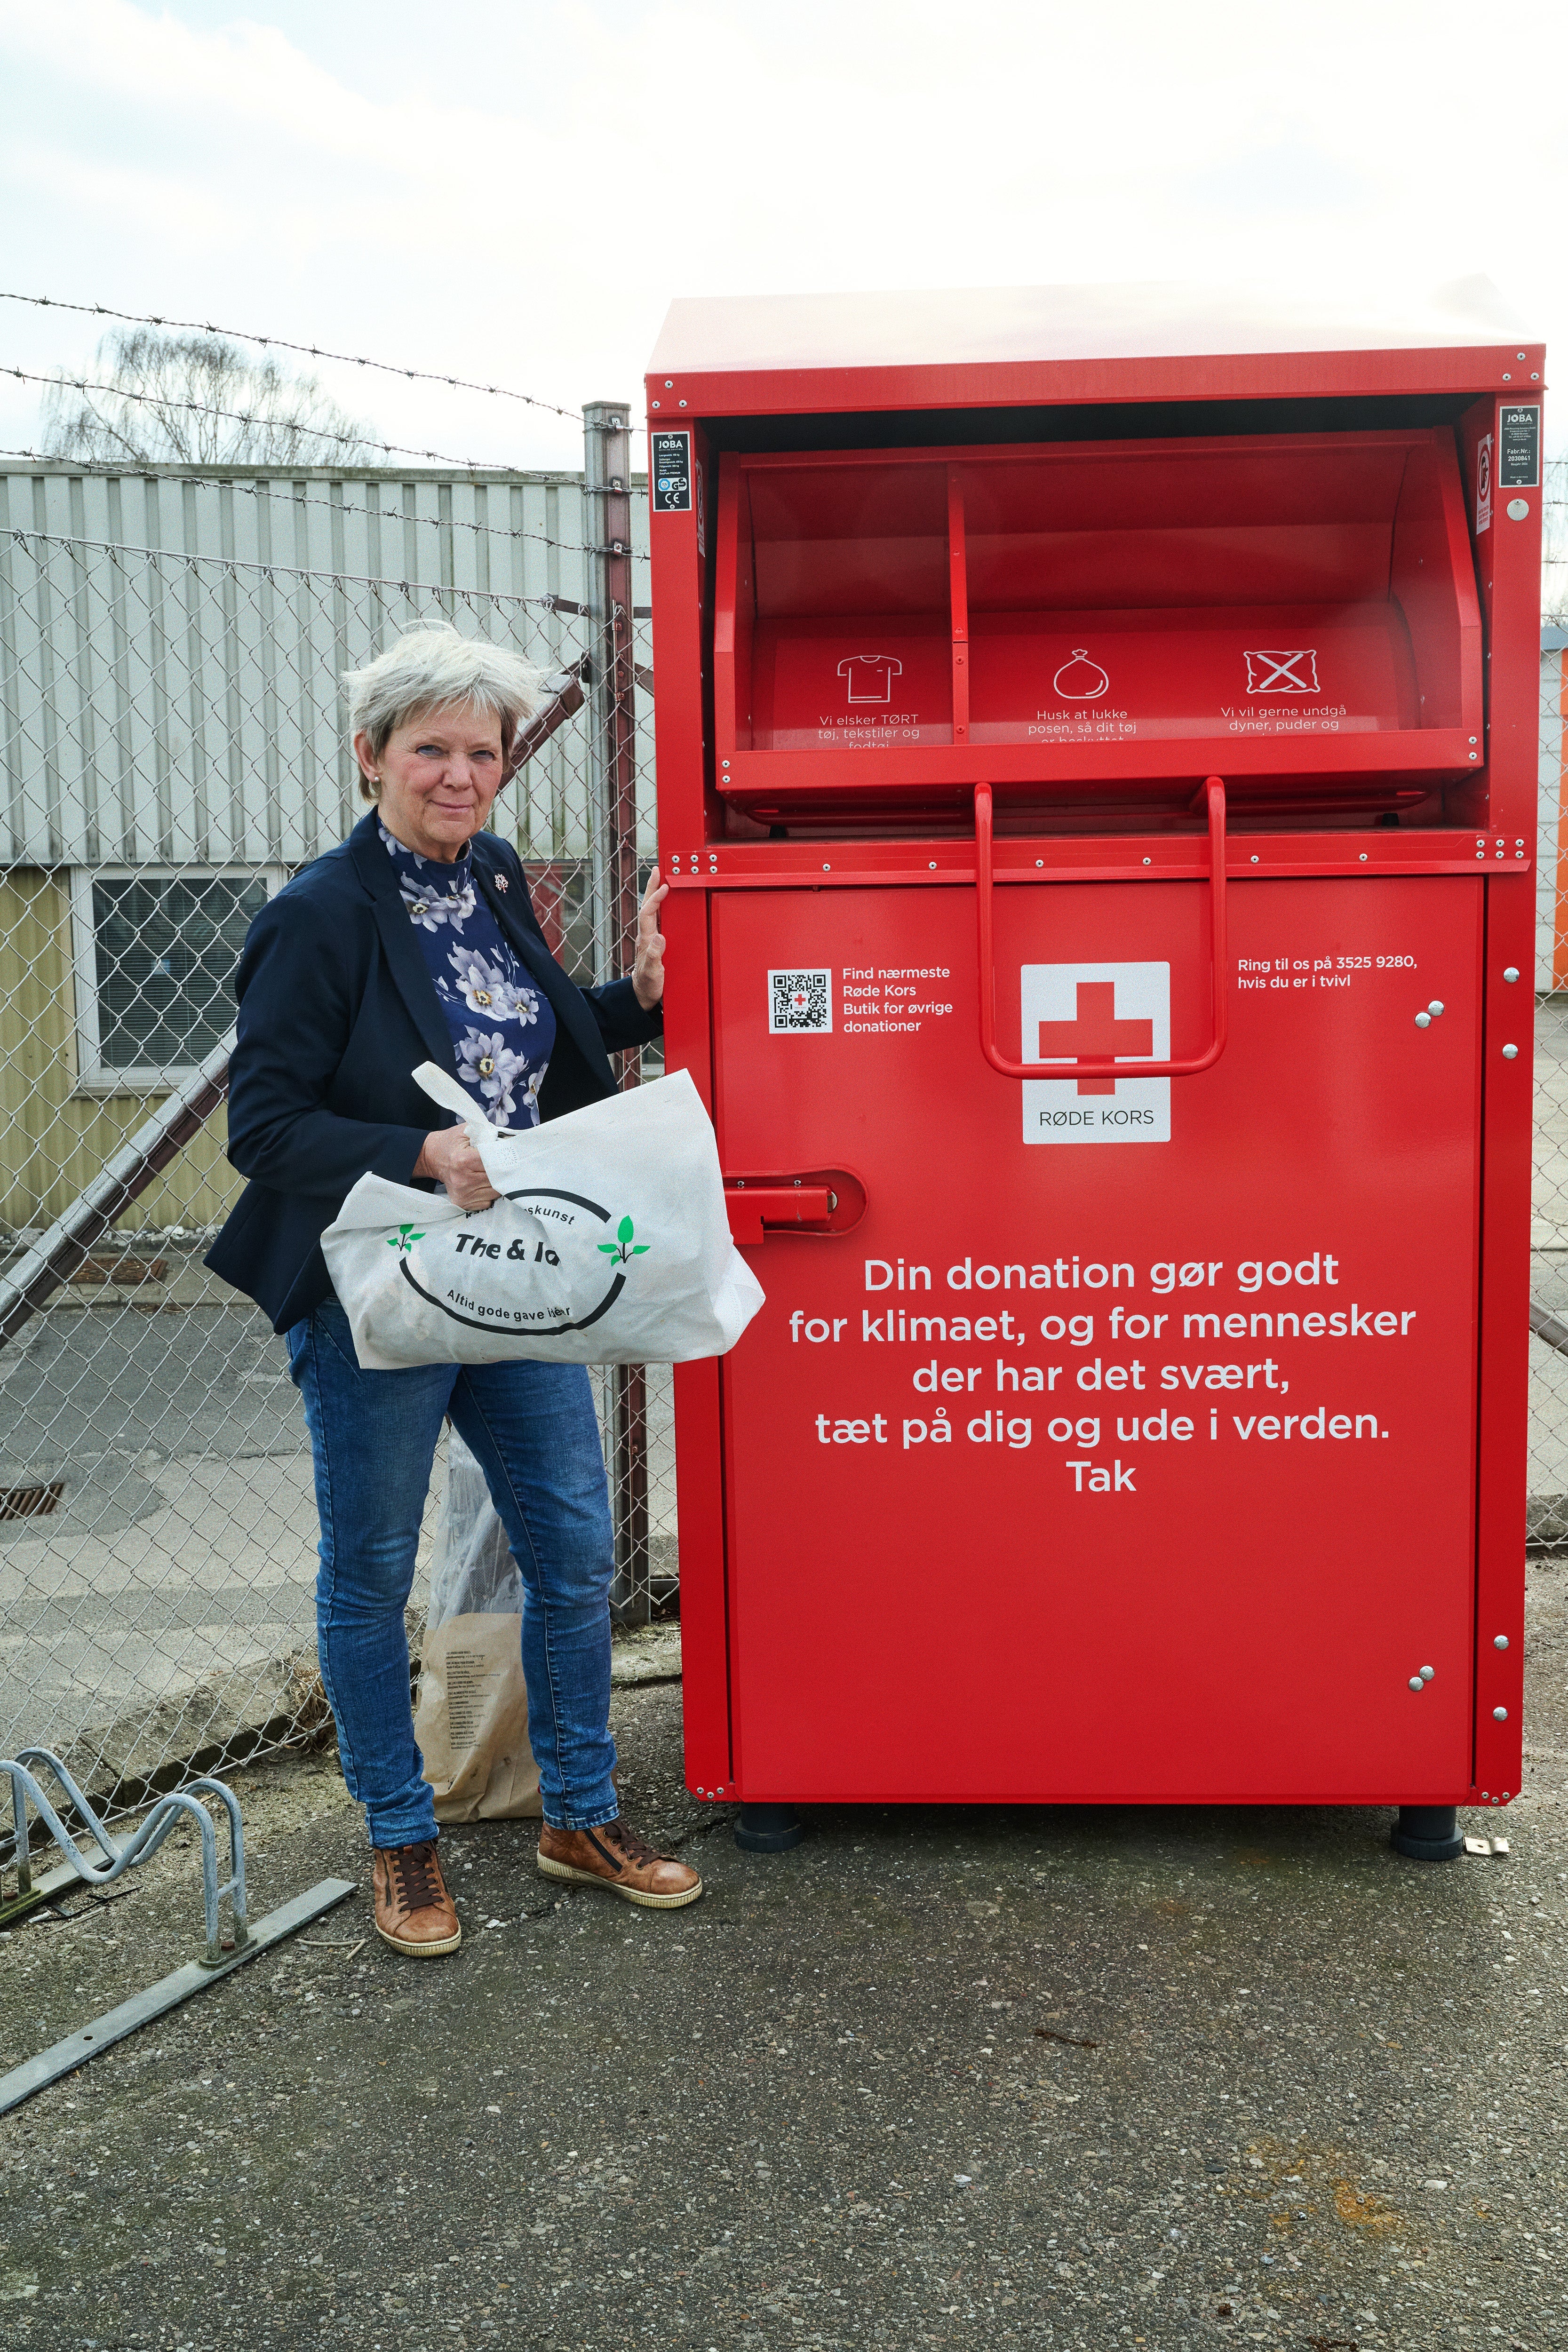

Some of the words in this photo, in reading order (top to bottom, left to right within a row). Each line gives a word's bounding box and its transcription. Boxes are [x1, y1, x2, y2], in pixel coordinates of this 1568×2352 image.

[1507, 414, 1532, 422] JOBA
[659, 440, 683, 449] JOBA
[672, 478, 686, 490] GS
[665, 493, 679, 504] CE
[1037, 710, 1070, 720] Husk
[1075, 710, 1088, 720] at
[1092, 709, 1127, 719] lukke
[1221, 707, 1234, 717] Vi
[1239, 707, 1254, 717] vil
[1259, 707, 1298, 718] gerne
[1303, 705, 1346, 717] undgå
[820, 716, 832, 725] Vi
[837, 716, 876, 725] elsker
[882, 715, 918, 724] TØRT
[1229, 720, 1271, 732] dyner,
[1276, 720, 1316, 731] puder
[1321, 720, 1339, 731] og
[819, 729, 839, 740] tøj,
[844, 728, 898, 738] tekstiler
[903, 728, 920, 739] og
[1028, 724, 1073, 735] posen,
[1078, 722, 1091, 732] så
[1097, 723, 1114, 732] dit
[1119, 722, 1136, 734] tøj
[1238, 959, 1271, 973] Ring
[1275, 958, 1288, 970] til
[1293, 960, 1310, 970] os
[1314, 955, 1332, 972] på
[1336, 956, 1371, 969] 3525
[1376, 955, 1417, 969] 9280,
[843, 967, 874, 979] Find
[878, 967, 950, 979] nærmeste
[1238, 976, 1266, 989] hvis
[1270, 976, 1289, 988] du
[1293, 978, 1308, 988] er
[1312, 975, 1315, 987] i
[1320, 974, 1350, 987] tvivl
[843, 985, 880, 997] Røde
[884, 985, 916, 996] Kors
[844, 1002, 880, 1015] Butik
[883, 1002, 904, 1014] for
[907, 1001, 953, 1016] øvrige
[844, 1020, 922, 1033] donationer
[1040, 1111, 1094, 1126] RØDE
[1102, 1110, 1154, 1125] KORS
[524, 1205, 575, 1225] skunst
[455, 1233, 501, 1259] The
[507, 1239, 525, 1260] &
[865, 1258, 931, 1291] Din
[947, 1255, 1134, 1290] donation
[1150, 1262, 1223, 1294] gør
[1237, 1252, 1339, 1293] godt
[447, 1290, 474, 1311] Altid
[478, 1306, 510, 1318] gode
[514, 1311, 544, 1322] gave
[789, 1310, 848, 1343] for
[862, 1309, 1025, 1346] klimaet,
[1041, 1315, 1093, 1346] og
[1109, 1306, 1169, 1339] for
[1184, 1303, 1416, 1338] mennesker
[913, 1359, 982, 1392] der
[997, 1359, 1062, 1391] har
[1076, 1358, 1146, 1391] det
[1160, 1358, 1289, 1394] svært,
[815, 1414, 888, 1444] tæt
[903, 1407, 952, 1449] på
[967, 1410, 1032, 1449] dig
[1048, 1417, 1100, 1448] og
[1117, 1408, 1194, 1441] ude
[1210, 1408, 1217, 1440] i
[1233, 1406, 1389, 1440] verden.
[1066, 1459, 1137, 1492] Tak
